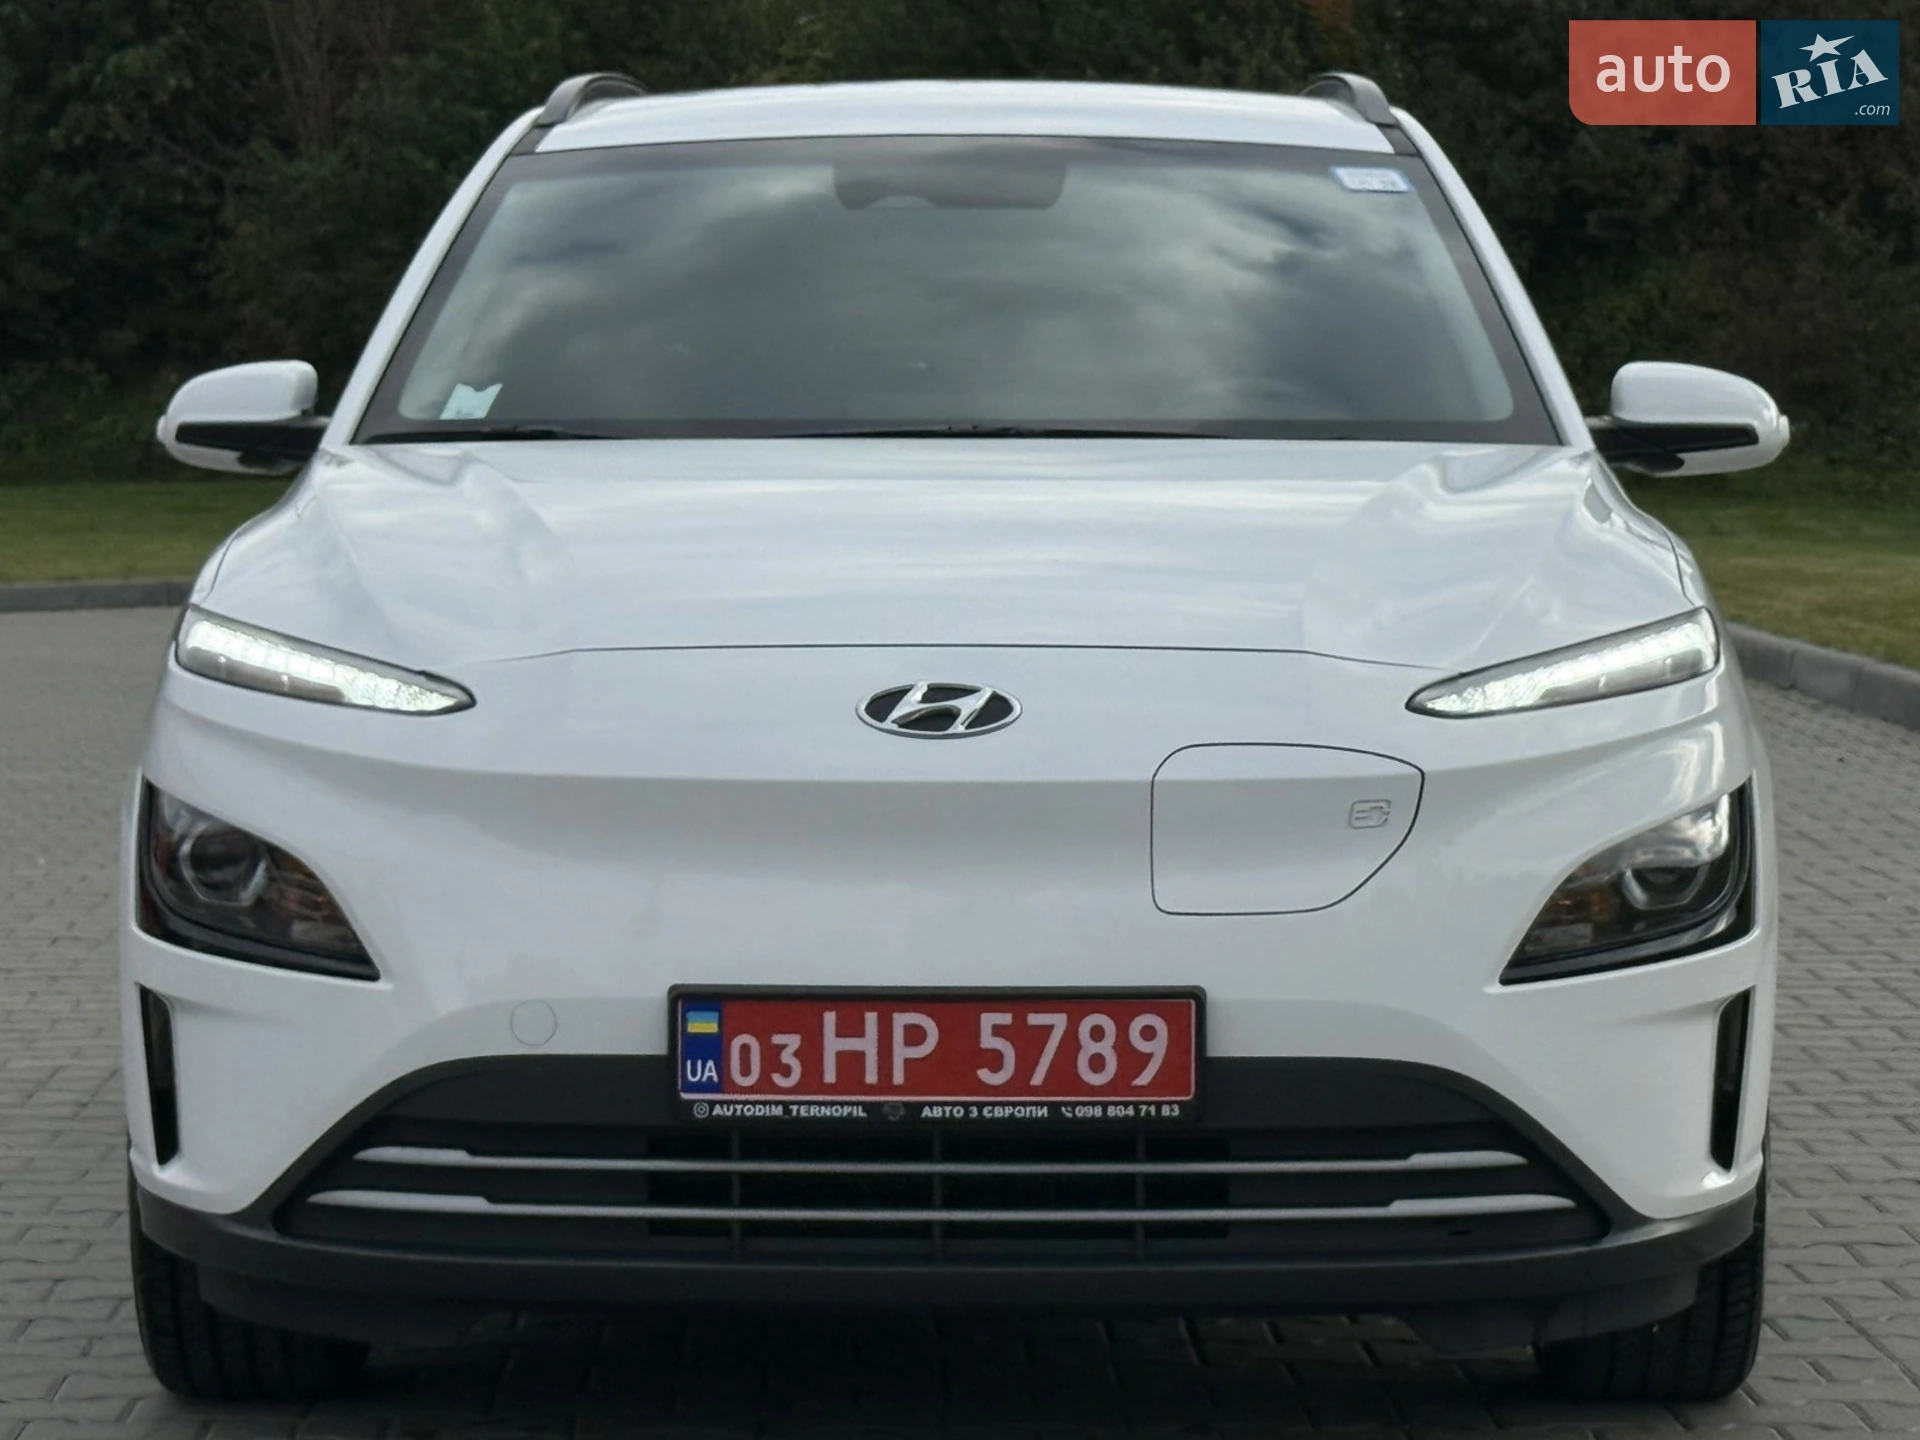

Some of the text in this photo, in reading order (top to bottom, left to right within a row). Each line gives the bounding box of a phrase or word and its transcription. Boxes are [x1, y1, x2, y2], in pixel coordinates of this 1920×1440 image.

[729, 1011, 1169, 1088] 03 HP 5789
[686, 1059, 719, 1083] UA
[920, 1105, 965, 1118] АВТО
[982, 1105, 1049, 1118] ЄВРОПИ
[1074, 1105, 1103, 1118] 098
[1106, 1105, 1135, 1117] 804
[1139, 1104, 1156, 1117] 71
